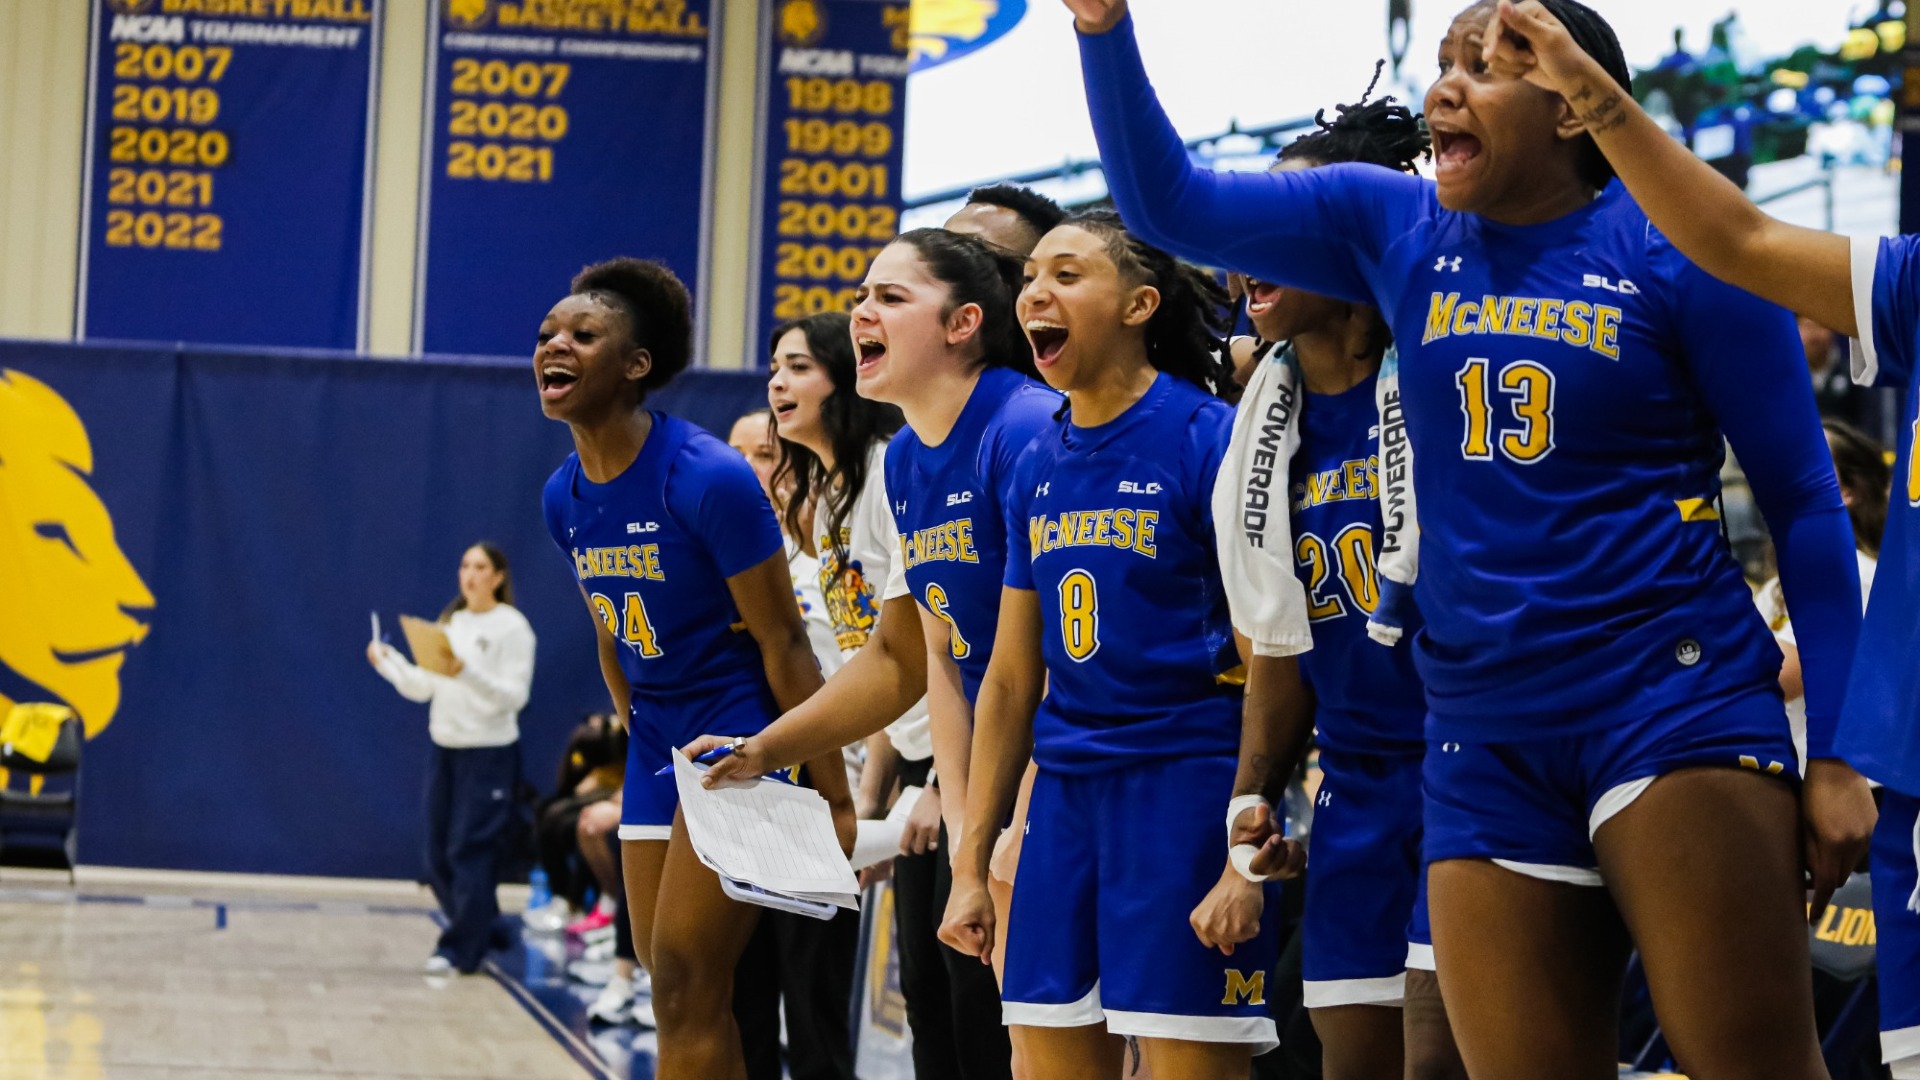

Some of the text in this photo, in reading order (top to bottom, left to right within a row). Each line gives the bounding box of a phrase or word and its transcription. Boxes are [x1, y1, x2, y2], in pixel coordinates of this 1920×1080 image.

[110, 15, 186, 42] NCAA
[114, 43, 234, 81] 2007
[451, 58, 570, 97] 2007
[112, 84, 220, 124] 2019
[785, 77, 892, 114] 1998
[449, 100, 569, 140] 2020
[785, 119, 891, 156] 1999
[110, 127, 229, 166] 2020
[447, 142, 554, 181] 2021
[108, 168, 213, 206] 2021
[780, 159, 887, 197] 2001
[105, 210, 222, 250] 2022
[778, 200, 895, 239] 2002
[1583, 274, 1640, 294] SLC
[1455, 357, 1556, 465] 13
[1243, 384, 1293, 549] POWERADE
[1383, 390, 1406, 553] POWERADE
[947, 491, 973, 506] SLC
[1118, 481, 1162, 495] SLC
[627, 522, 660, 534] SLC
[1296, 522, 1380, 623] 20
[1058, 568, 1100, 663] 8
[1221, 969, 1266, 1005] M
